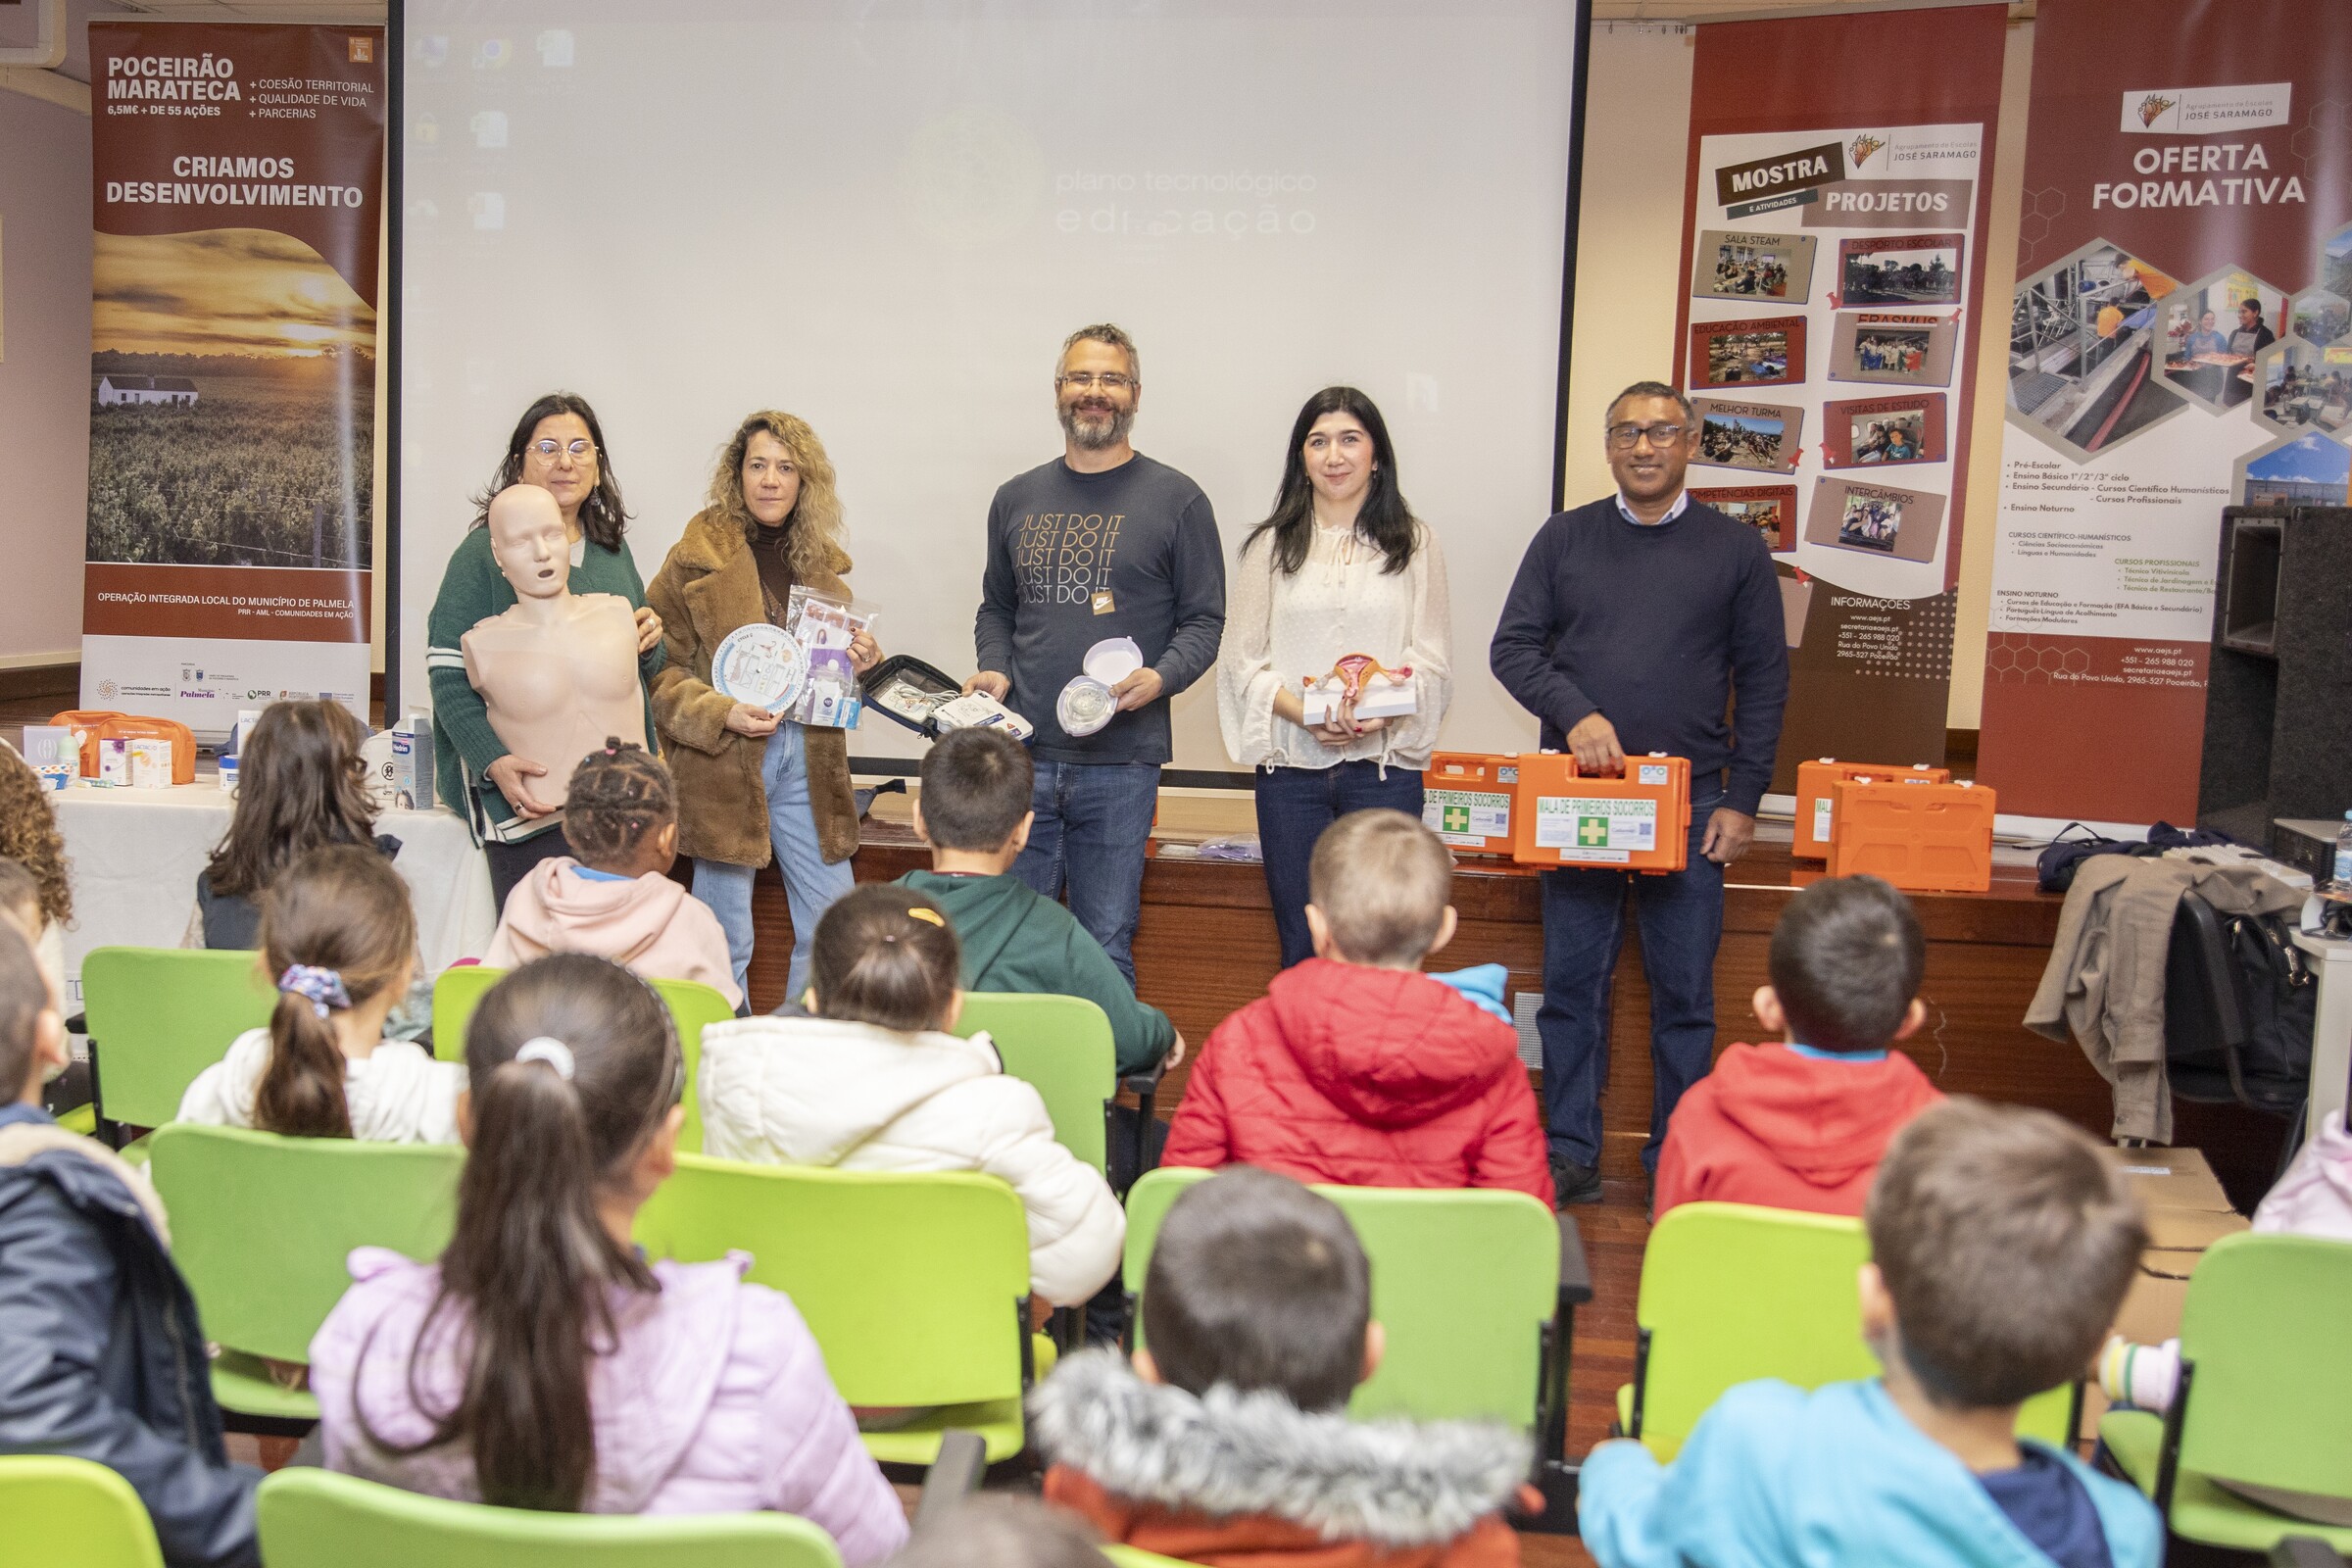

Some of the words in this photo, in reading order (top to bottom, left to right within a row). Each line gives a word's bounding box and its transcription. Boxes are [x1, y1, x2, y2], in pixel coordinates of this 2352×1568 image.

[108, 54, 233, 77] POCEIRÃO
[108, 80, 241, 100] MARATECA
[259, 77, 303, 89] COESÃO
[306, 80, 373, 92] TERRITORIAL
[259, 94, 320, 105] QUALIDADE
[322, 95, 338, 106] DE
[340, 96, 367, 107] VIDA
[108, 106, 138, 116] 6,5M€
[150, 106, 165, 115] DE
[168, 106, 181, 116] 55
[184, 105, 220, 118] AÇÕES
[259, 108, 316, 119] PARCERIAS
[2184, 111, 2209, 120] JOSÉ
[2213, 109, 2273, 119] SARAMAGO
[1893, 152, 1917, 161] JOSÉ
[1921, 151, 1976, 160] SARAMAGO
[2133, 144, 2269, 174] OFERTA
[173, 157, 294, 178] CRIAMOS
[1733, 155, 1829, 192] MOSTRA
[107, 182, 363, 208] DESENVOLVIMENTO
[2092, 176, 2305, 209] FORMATIVA
[1756, 197, 1796, 211] ATIVIDADES
[1826, 192, 1948, 212] PROJETOS
[1725, 235, 1747, 244] SALA
[1749, 236, 1780, 246] STEAM
[1694, 321, 1747, 335] EDUCAÇÃO
[1750, 319, 1800, 331] AMBIENTAL
[1710, 404, 1747, 415] MELHOR
[1749, 407, 1782, 417] TURMA
[1840, 404, 1874, 415] VISITAS
[1878, 403, 1889, 412] DE
[1891, 400, 1929, 410] ESTUDO
[1756, 487, 1793, 497] DIGITAIS
[1844, 486, 1914, 504] INTERCÂMBIOS
[2041, 483, 2089, 492] Secundário
[2129, 485, 2168, 494] Científico
[2127, 496, 2181, 505] Profissionais
[1019, 514, 1064, 531] JUST
[1066, 514, 1102, 531] DO
[1106, 515, 1125, 531] IT
[1015, 531, 1059, 550] JUST
[1062, 531, 1098, 548] DO
[1102, 532, 1120, 548] IT
[1016, 549, 1055, 567] JUST
[1059, 549, 1094, 566] DO
[1099, 549, 1115, 566] IT
[1018, 566, 1053, 585] JUST
[1057, 566, 1091, 585] DO
[1096, 568, 1112, 585] IT
[2161, 577, 2202, 586] Jardinagem
[98, 592, 146, 604] OPERAÇÃO
[149, 594, 200, 605] INTEGRADA
[202, 596, 230, 606] LOCAL
[248, 596, 296, 608] MUNICÍPIO
[298, 599, 311, 608] DE
[313, 600, 354, 609] PALMELA
[1023, 585, 1053, 604] JUST
[1056, 585, 1089, 605] DO
[1831, 596, 1910, 612] INFORMAÇÕES
[2160, 605, 2203, 613] Secundário)
[336, 611, 354, 619] AÇÃO
[1850, 614, 1890, 623] www.aejs.pt
[2101, 675, 2125, 684] Unido,
[2128, 676, 2164, 685] 2965-327
[2166, 678, 2201, 688] Poceirão,
[1429, 791, 1437, 804] DE
[1561, 800, 1570, 814] DE
